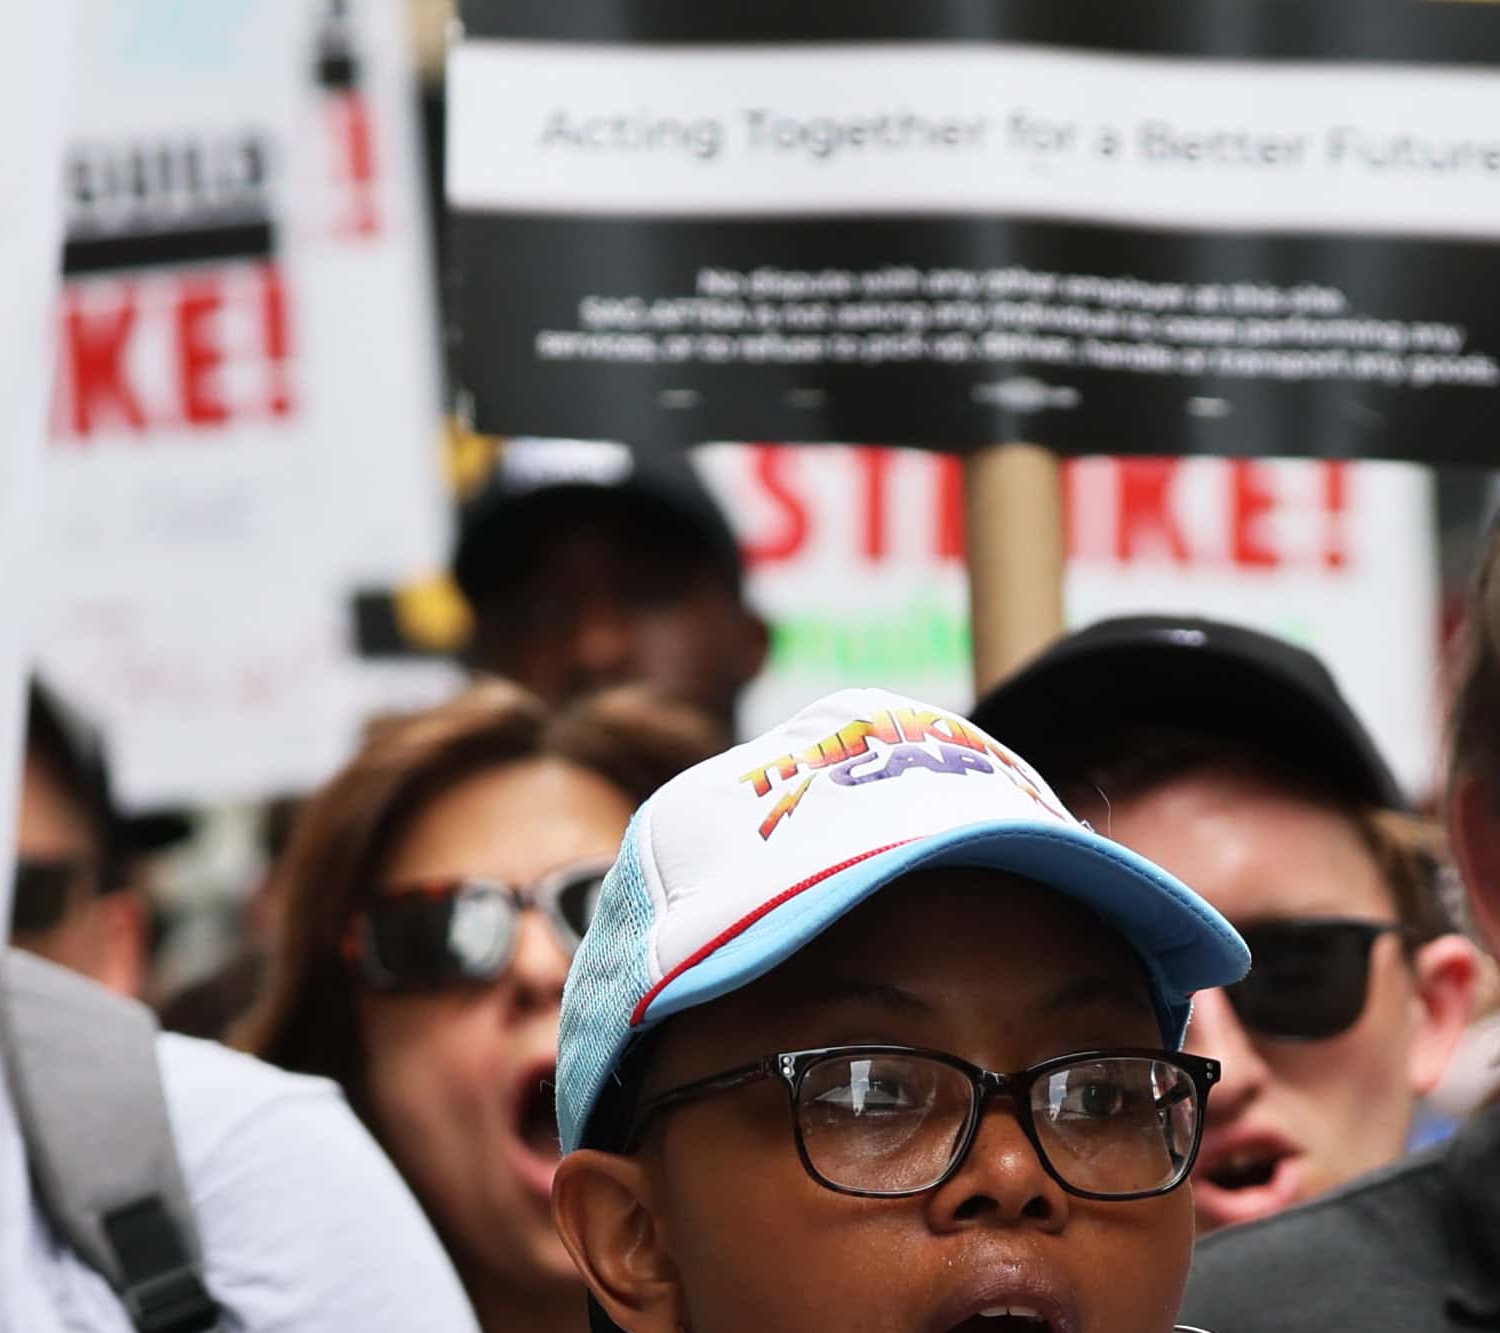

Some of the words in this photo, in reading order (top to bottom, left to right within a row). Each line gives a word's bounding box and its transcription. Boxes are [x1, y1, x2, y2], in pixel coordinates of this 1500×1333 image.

[538, 106, 726, 163] Acting
[741, 103, 989, 161] Together
[1005, 103, 1077, 152] for
[1097, 128, 1120, 158] a
[1136, 117, 1306, 165] Better
[746, 443, 1350, 570] STKE!
[828, 744, 995, 787] CAP
